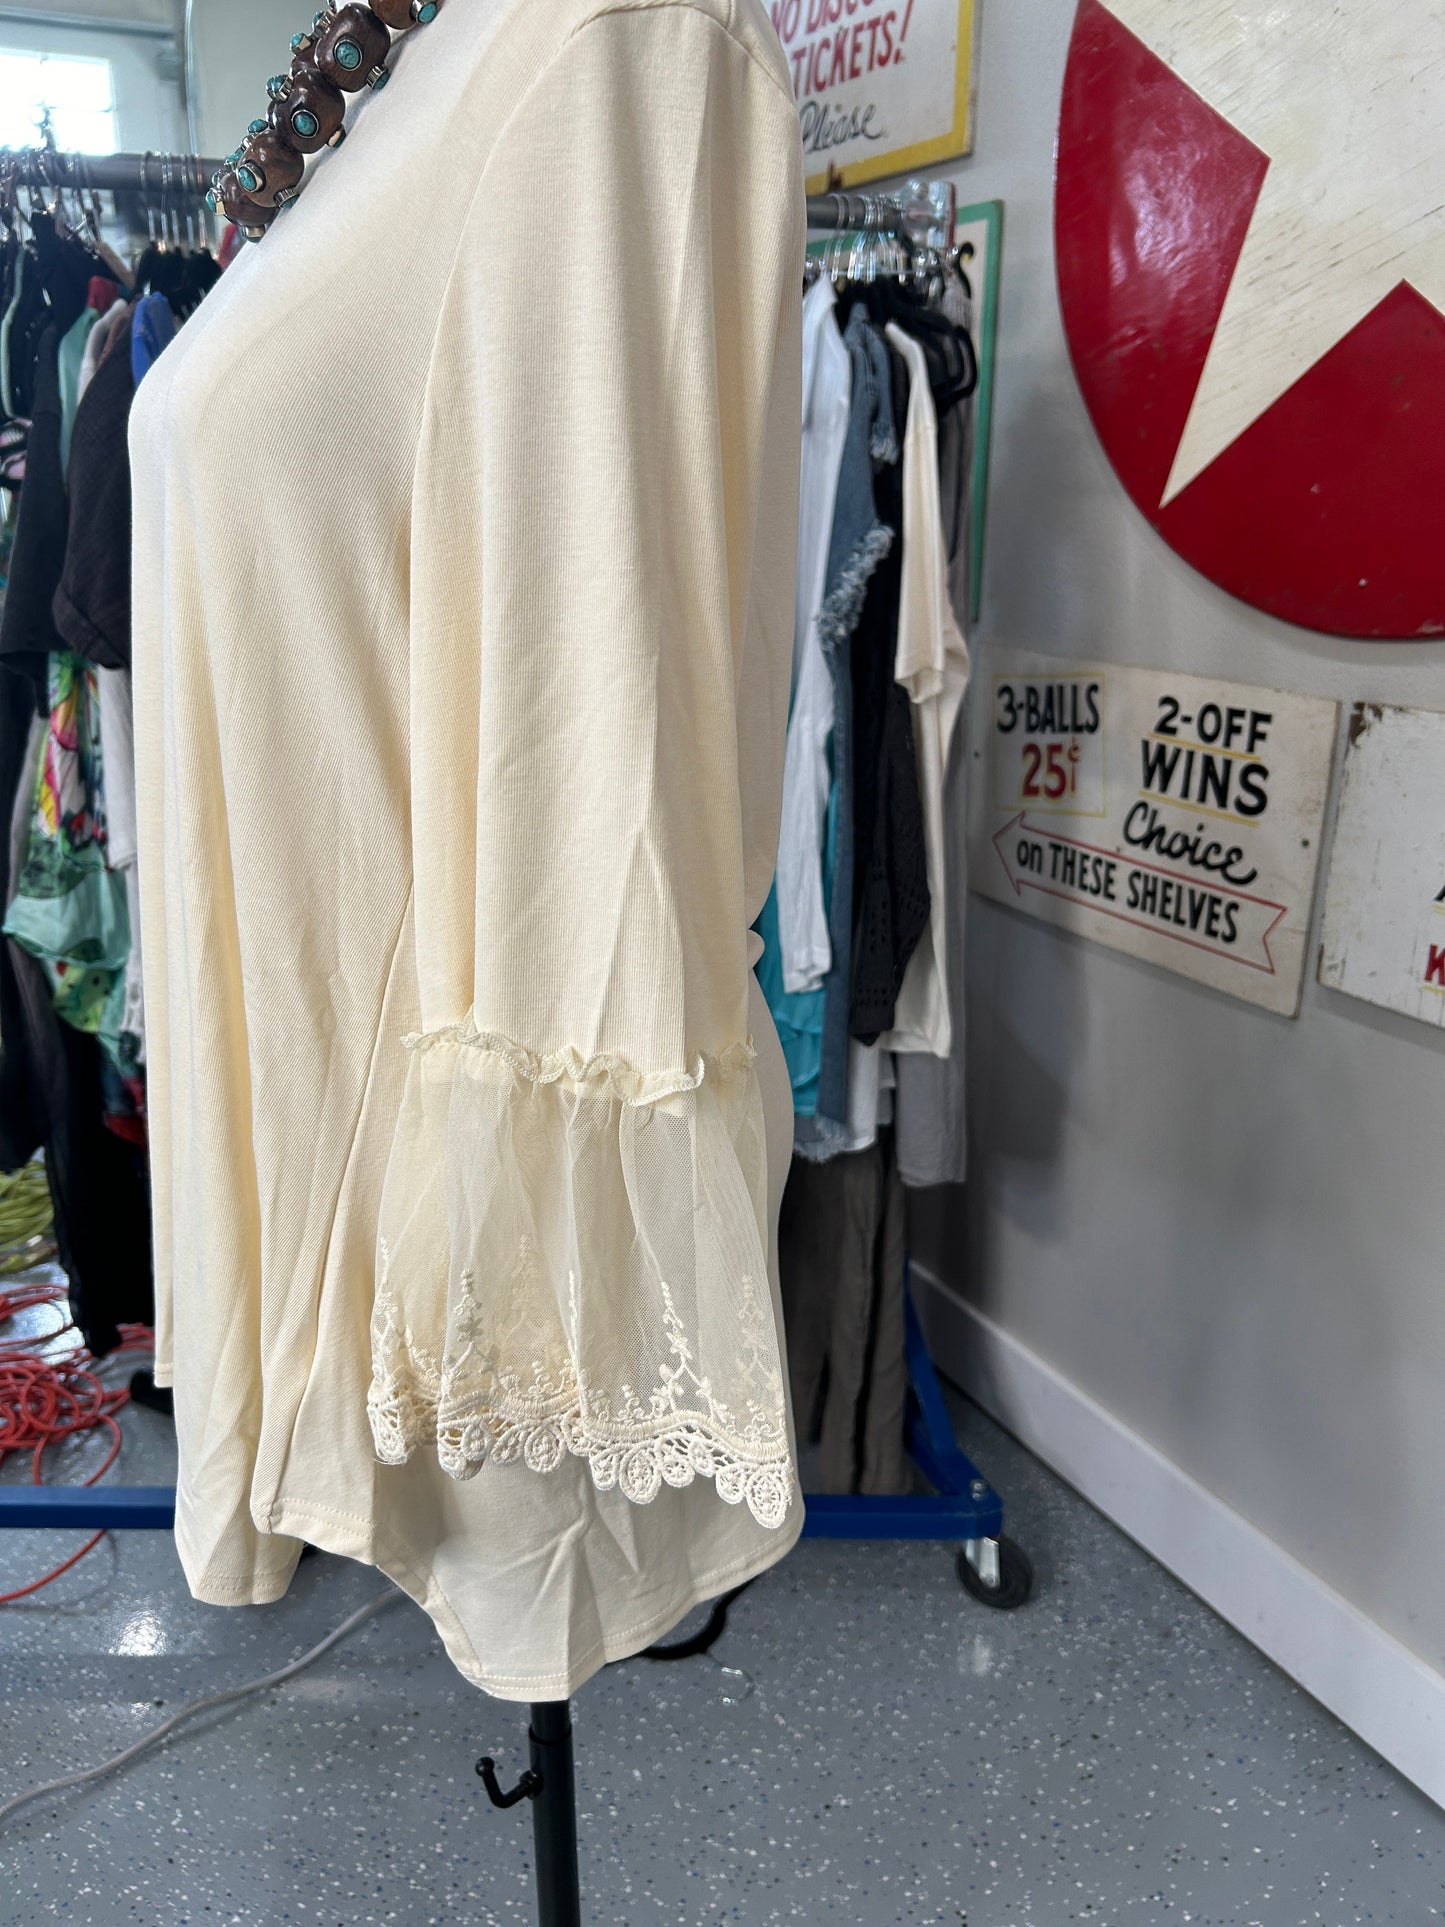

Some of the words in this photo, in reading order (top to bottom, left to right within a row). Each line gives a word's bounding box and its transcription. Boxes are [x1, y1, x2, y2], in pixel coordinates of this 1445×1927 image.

[771, 0, 800, 43] NO
[790, 0, 914, 99] TICKETS!
[800, 101, 886, 153] Please
[997, 683, 1099, 734] 3-BALLS
[1153, 696, 1272, 753] 2-OFF
[1141, 739, 1269, 816] WINS
[1123, 801, 1258, 886] Choice
[1016, 838, 1042, 874] on
[1047, 842, 1116, 901] THESE
[1126, 870, 1239, 943] SHELVES
